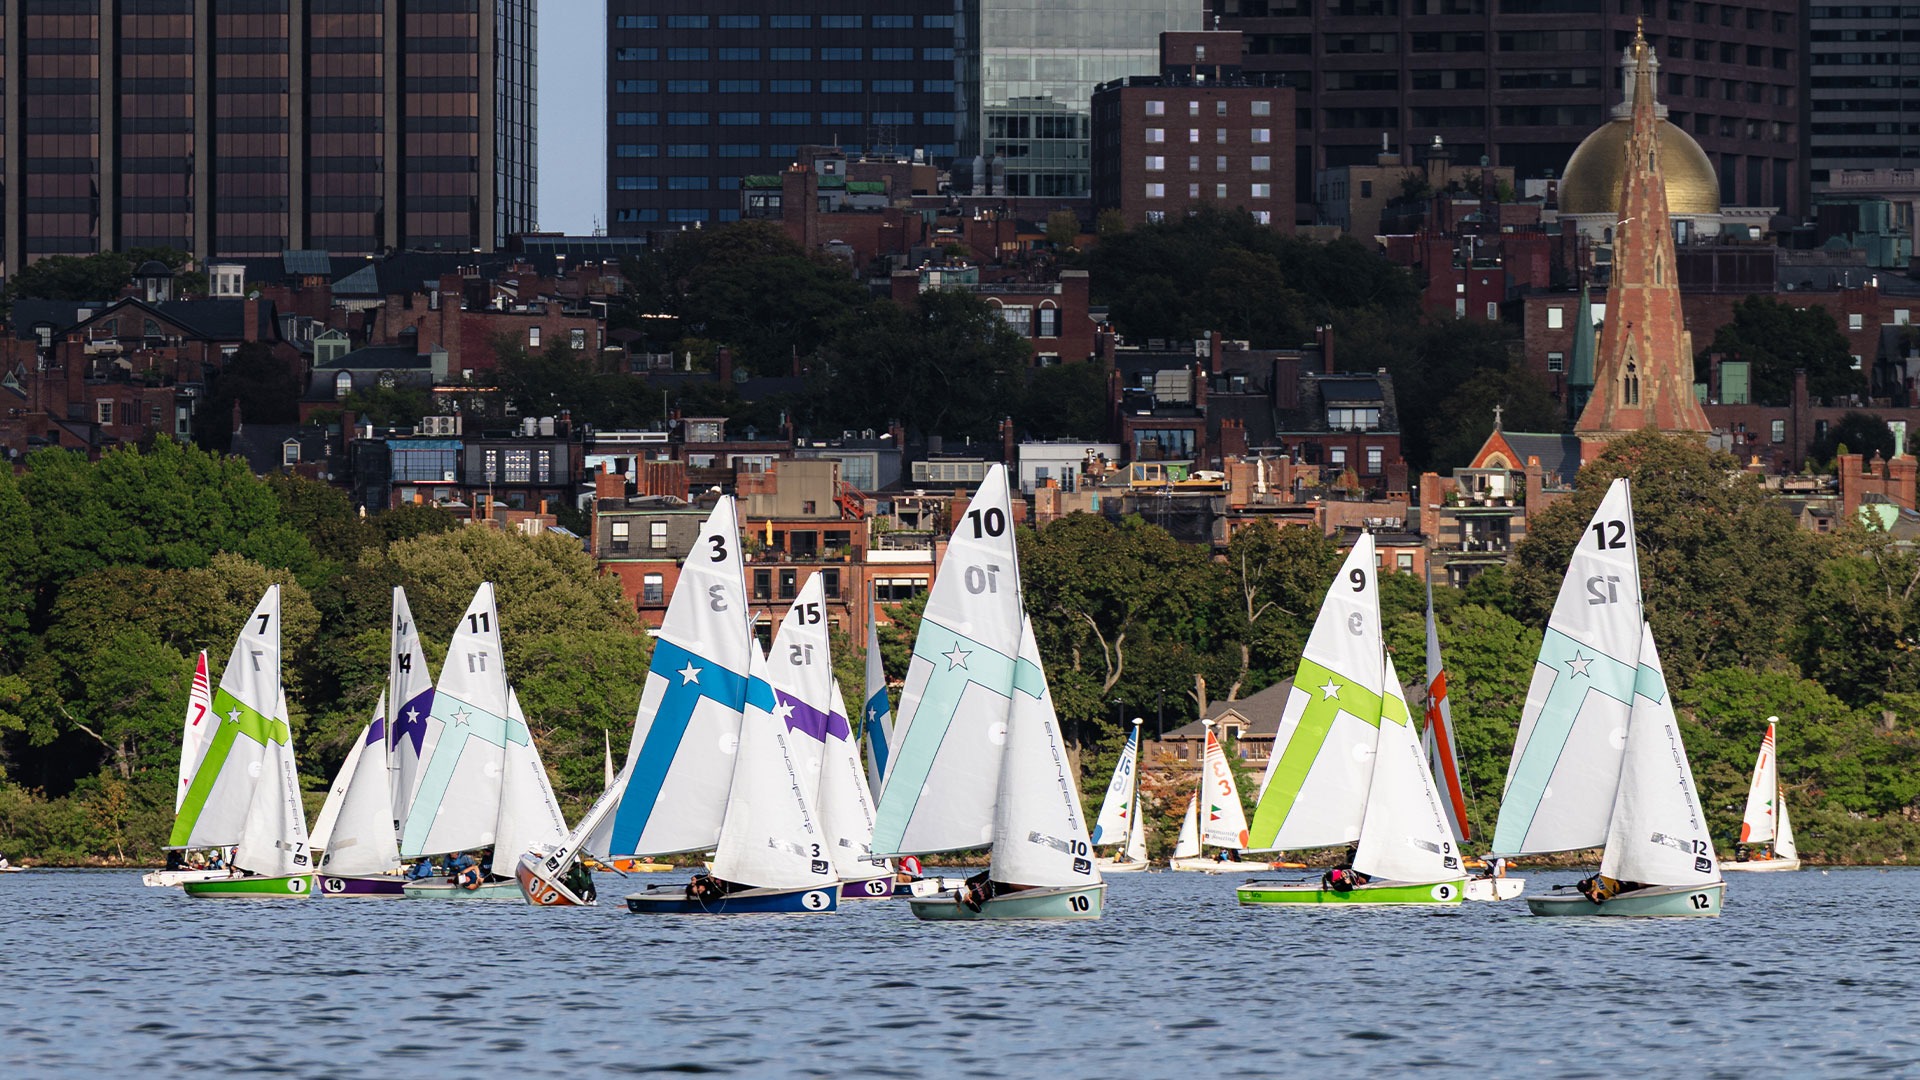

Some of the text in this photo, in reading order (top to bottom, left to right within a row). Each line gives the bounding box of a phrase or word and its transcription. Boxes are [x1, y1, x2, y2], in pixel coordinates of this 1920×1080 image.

[967, 507, 1005, 539] 10
[1591, 520, 1627, 550] 12
[708, 535, 728, 562] 3
[1349, 568, 1366, 592] 9
[794, 602, 821, 626] 15
[257, 614, 270, 635] 7
[467, 612, 491, 634] 11
[398, 653, 411, 674] 14
[192, 703, 207, 727] 7
[1119, 755, 1131, 776] 16
[777, 733, 814, 834] ENGINEERS
[1044, 721, 1078, 830] ENGINEERS
[1664, 724, 1699, 830] ENGINEERS
[1218, 779, 1232, 796] 3
[296, 842, 304, 853] 7
[555, 847, 568, 858] 5
[811, 843, 821, 858] 3
[1069, 839, 1087, 857] 10
[1443, 842, 1450, 854] 9
[1692, 839, 1708, 856] 12
[293, 880, 301, 892] 7
[328, 879, 342, 891] 14
[531, 879, 538, 892] 5
[869, 882, 883, 893] 15
[1439, 886, 1450, 899] 9
[544, 892, 556, 902] 5
[810, 893, 821, 908] 3
[1069, 895, 1089, 912] 10
[1690, 893, 1710, 910] 12
